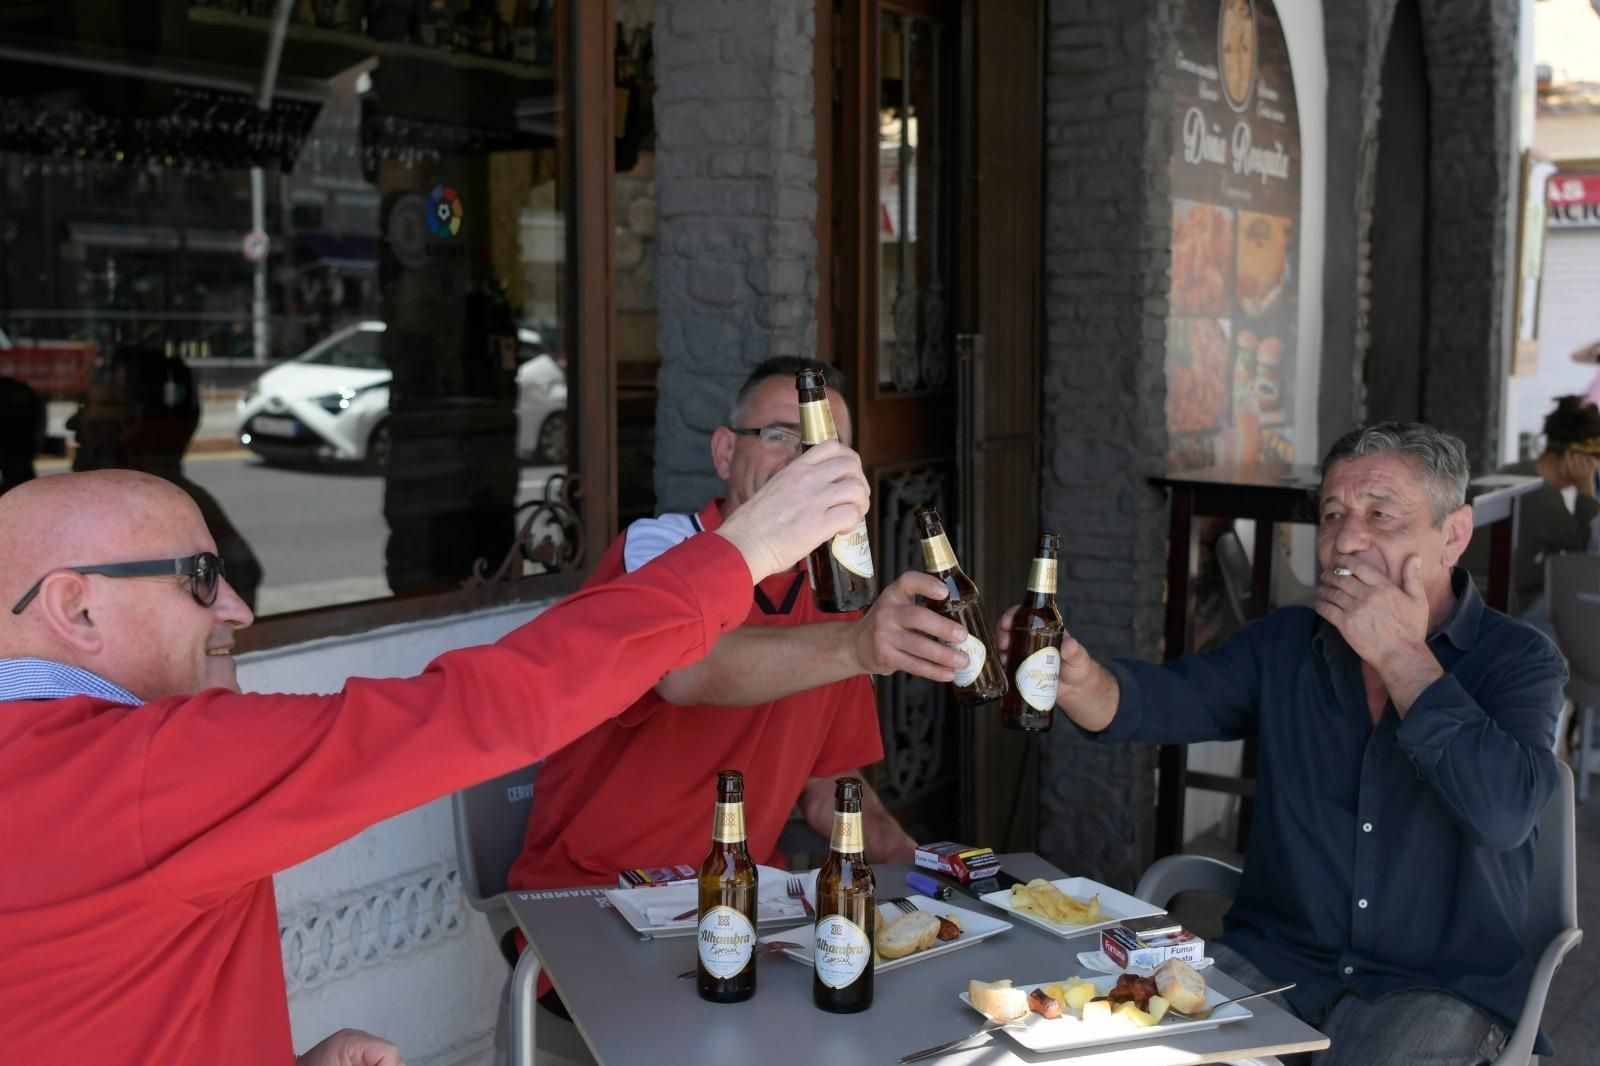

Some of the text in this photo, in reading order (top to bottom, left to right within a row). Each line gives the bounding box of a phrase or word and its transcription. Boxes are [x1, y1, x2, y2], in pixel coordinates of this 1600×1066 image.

[700, 929, 750, 945] Alhambra
[710, 943, 743, 958] Especial
[816, 937, 864, 955] Alhambra
[1170, 944, 1197, 955] Fumar
[822, 952, 855, 967] Especial
